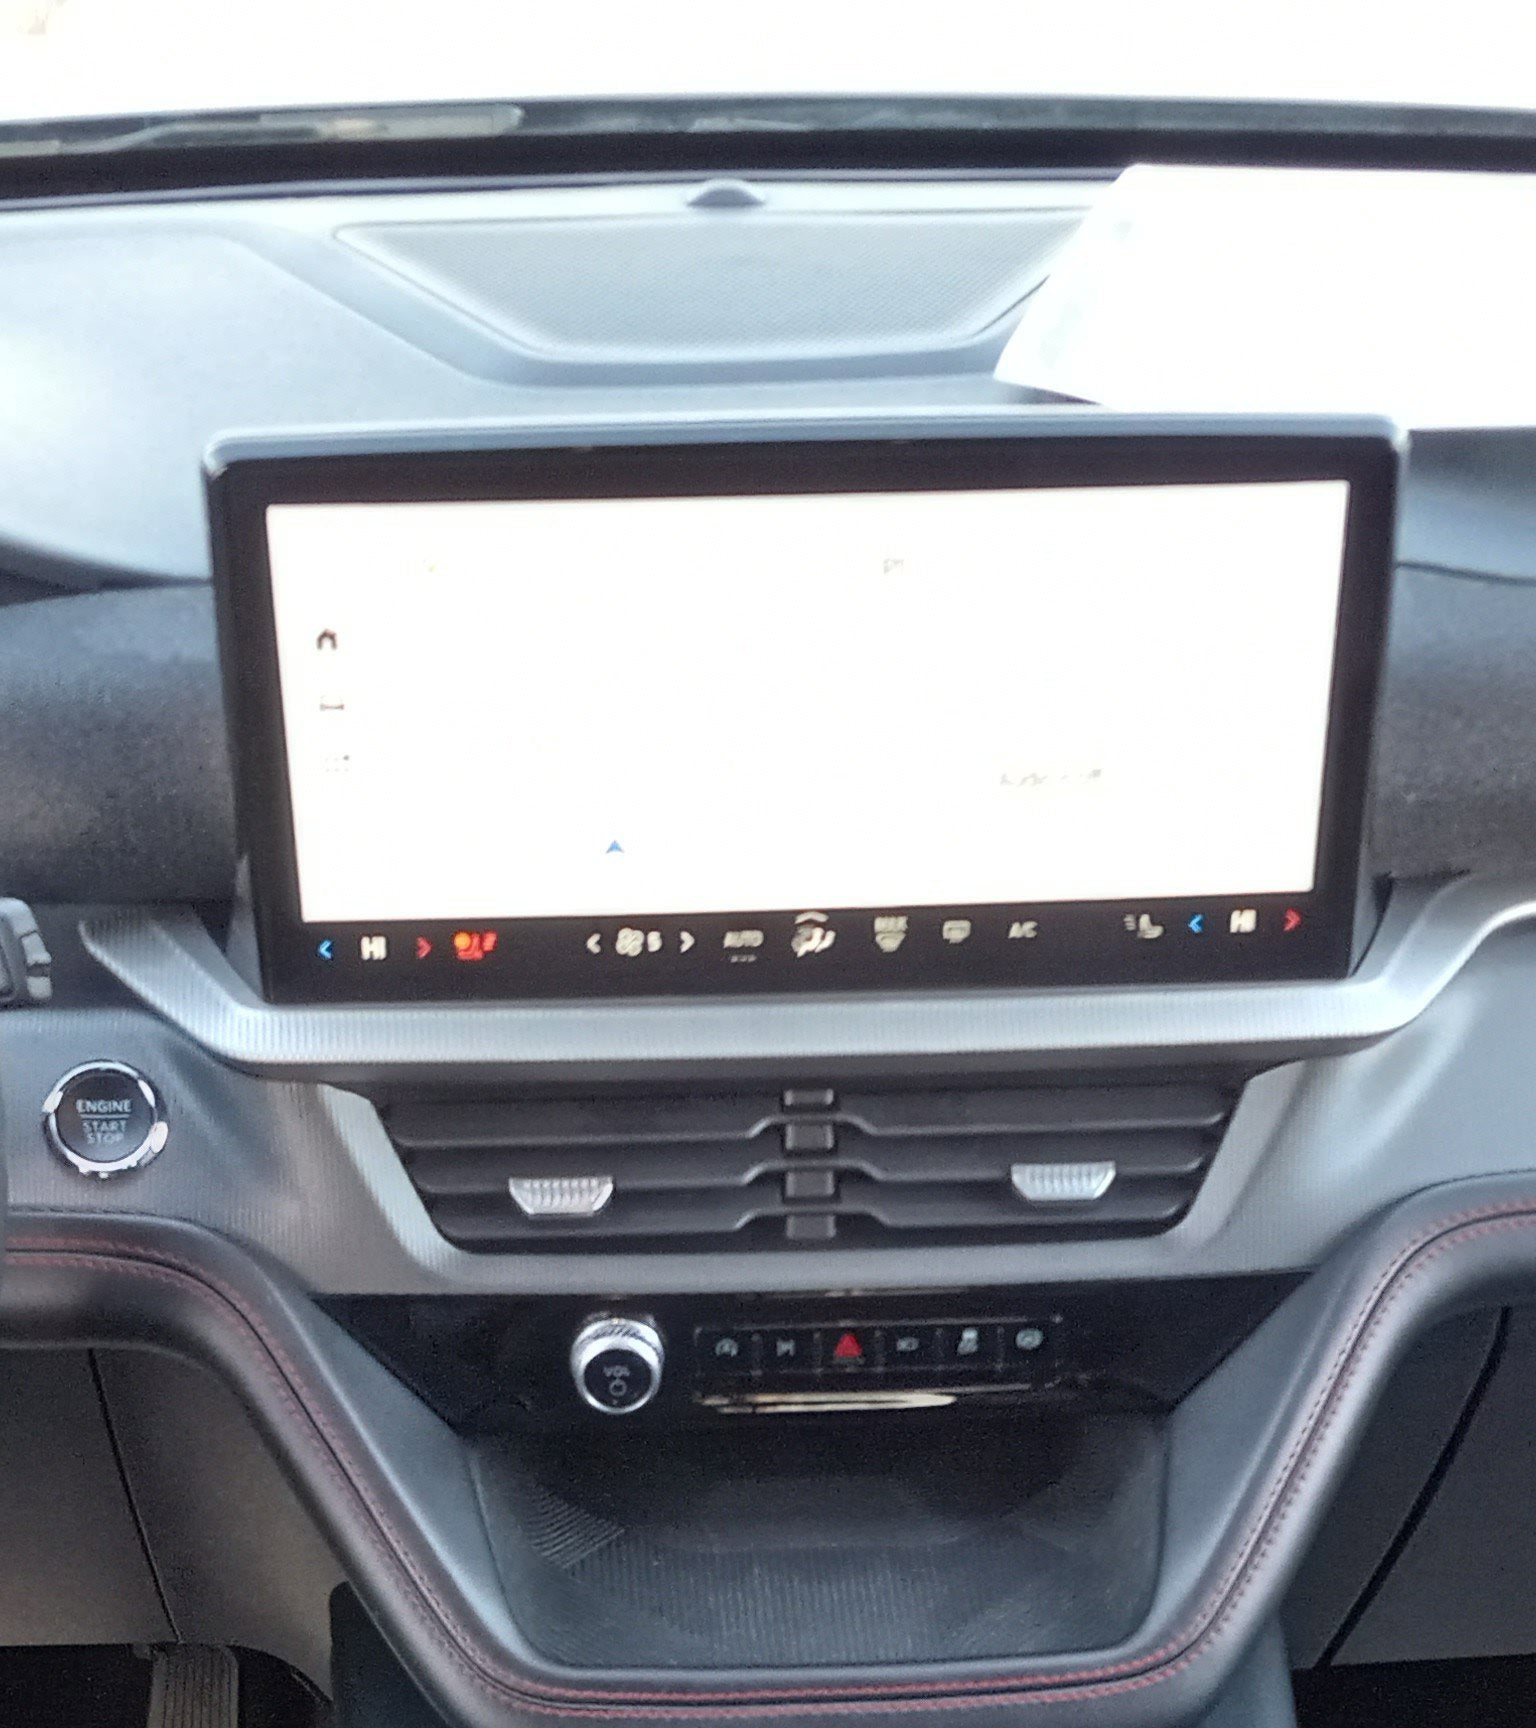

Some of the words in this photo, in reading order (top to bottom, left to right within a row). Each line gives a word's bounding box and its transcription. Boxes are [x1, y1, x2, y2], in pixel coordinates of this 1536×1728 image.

[75, 1099, 132, 1113] ENGINE
[82, 1120, 126, 1133] START
[87, 1133, 124, 1144] STOP
